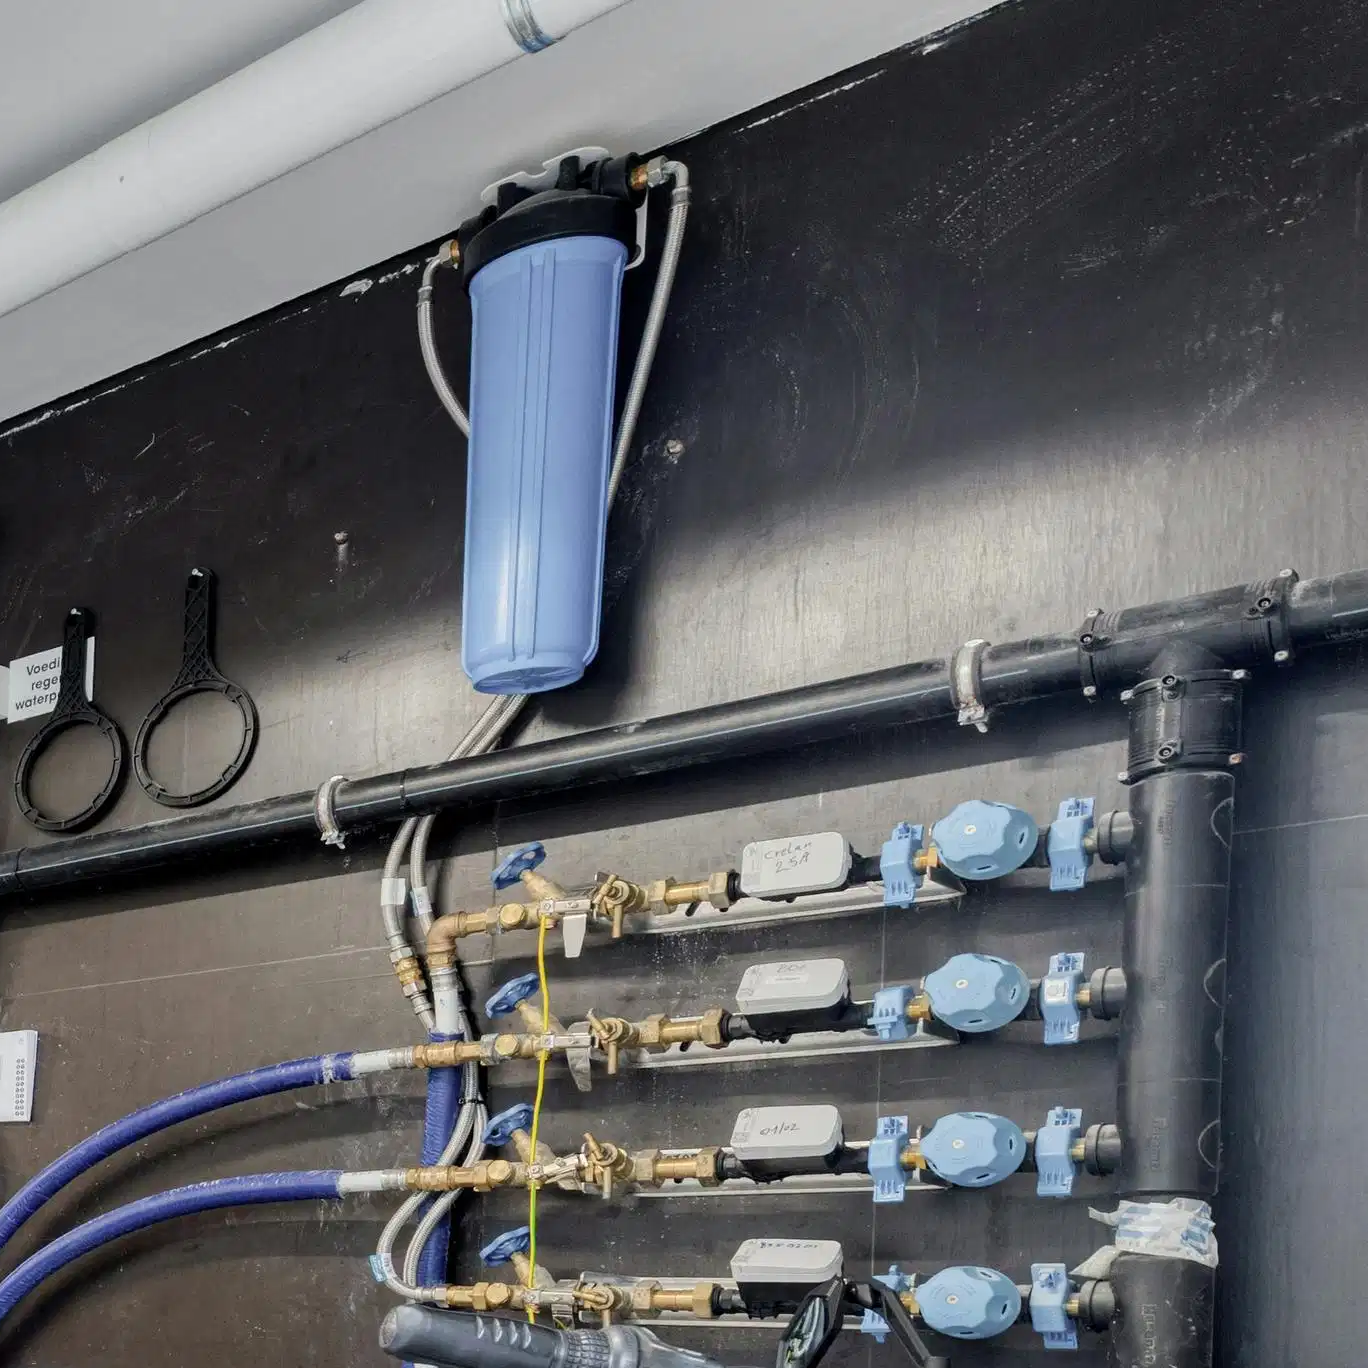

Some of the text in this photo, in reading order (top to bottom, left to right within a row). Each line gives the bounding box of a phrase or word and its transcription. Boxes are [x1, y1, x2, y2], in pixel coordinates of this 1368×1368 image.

[26, 656, 61, 676] Voedi
[31, 674, 61, 690] rege
[15, 691, 61, 710] waterp
